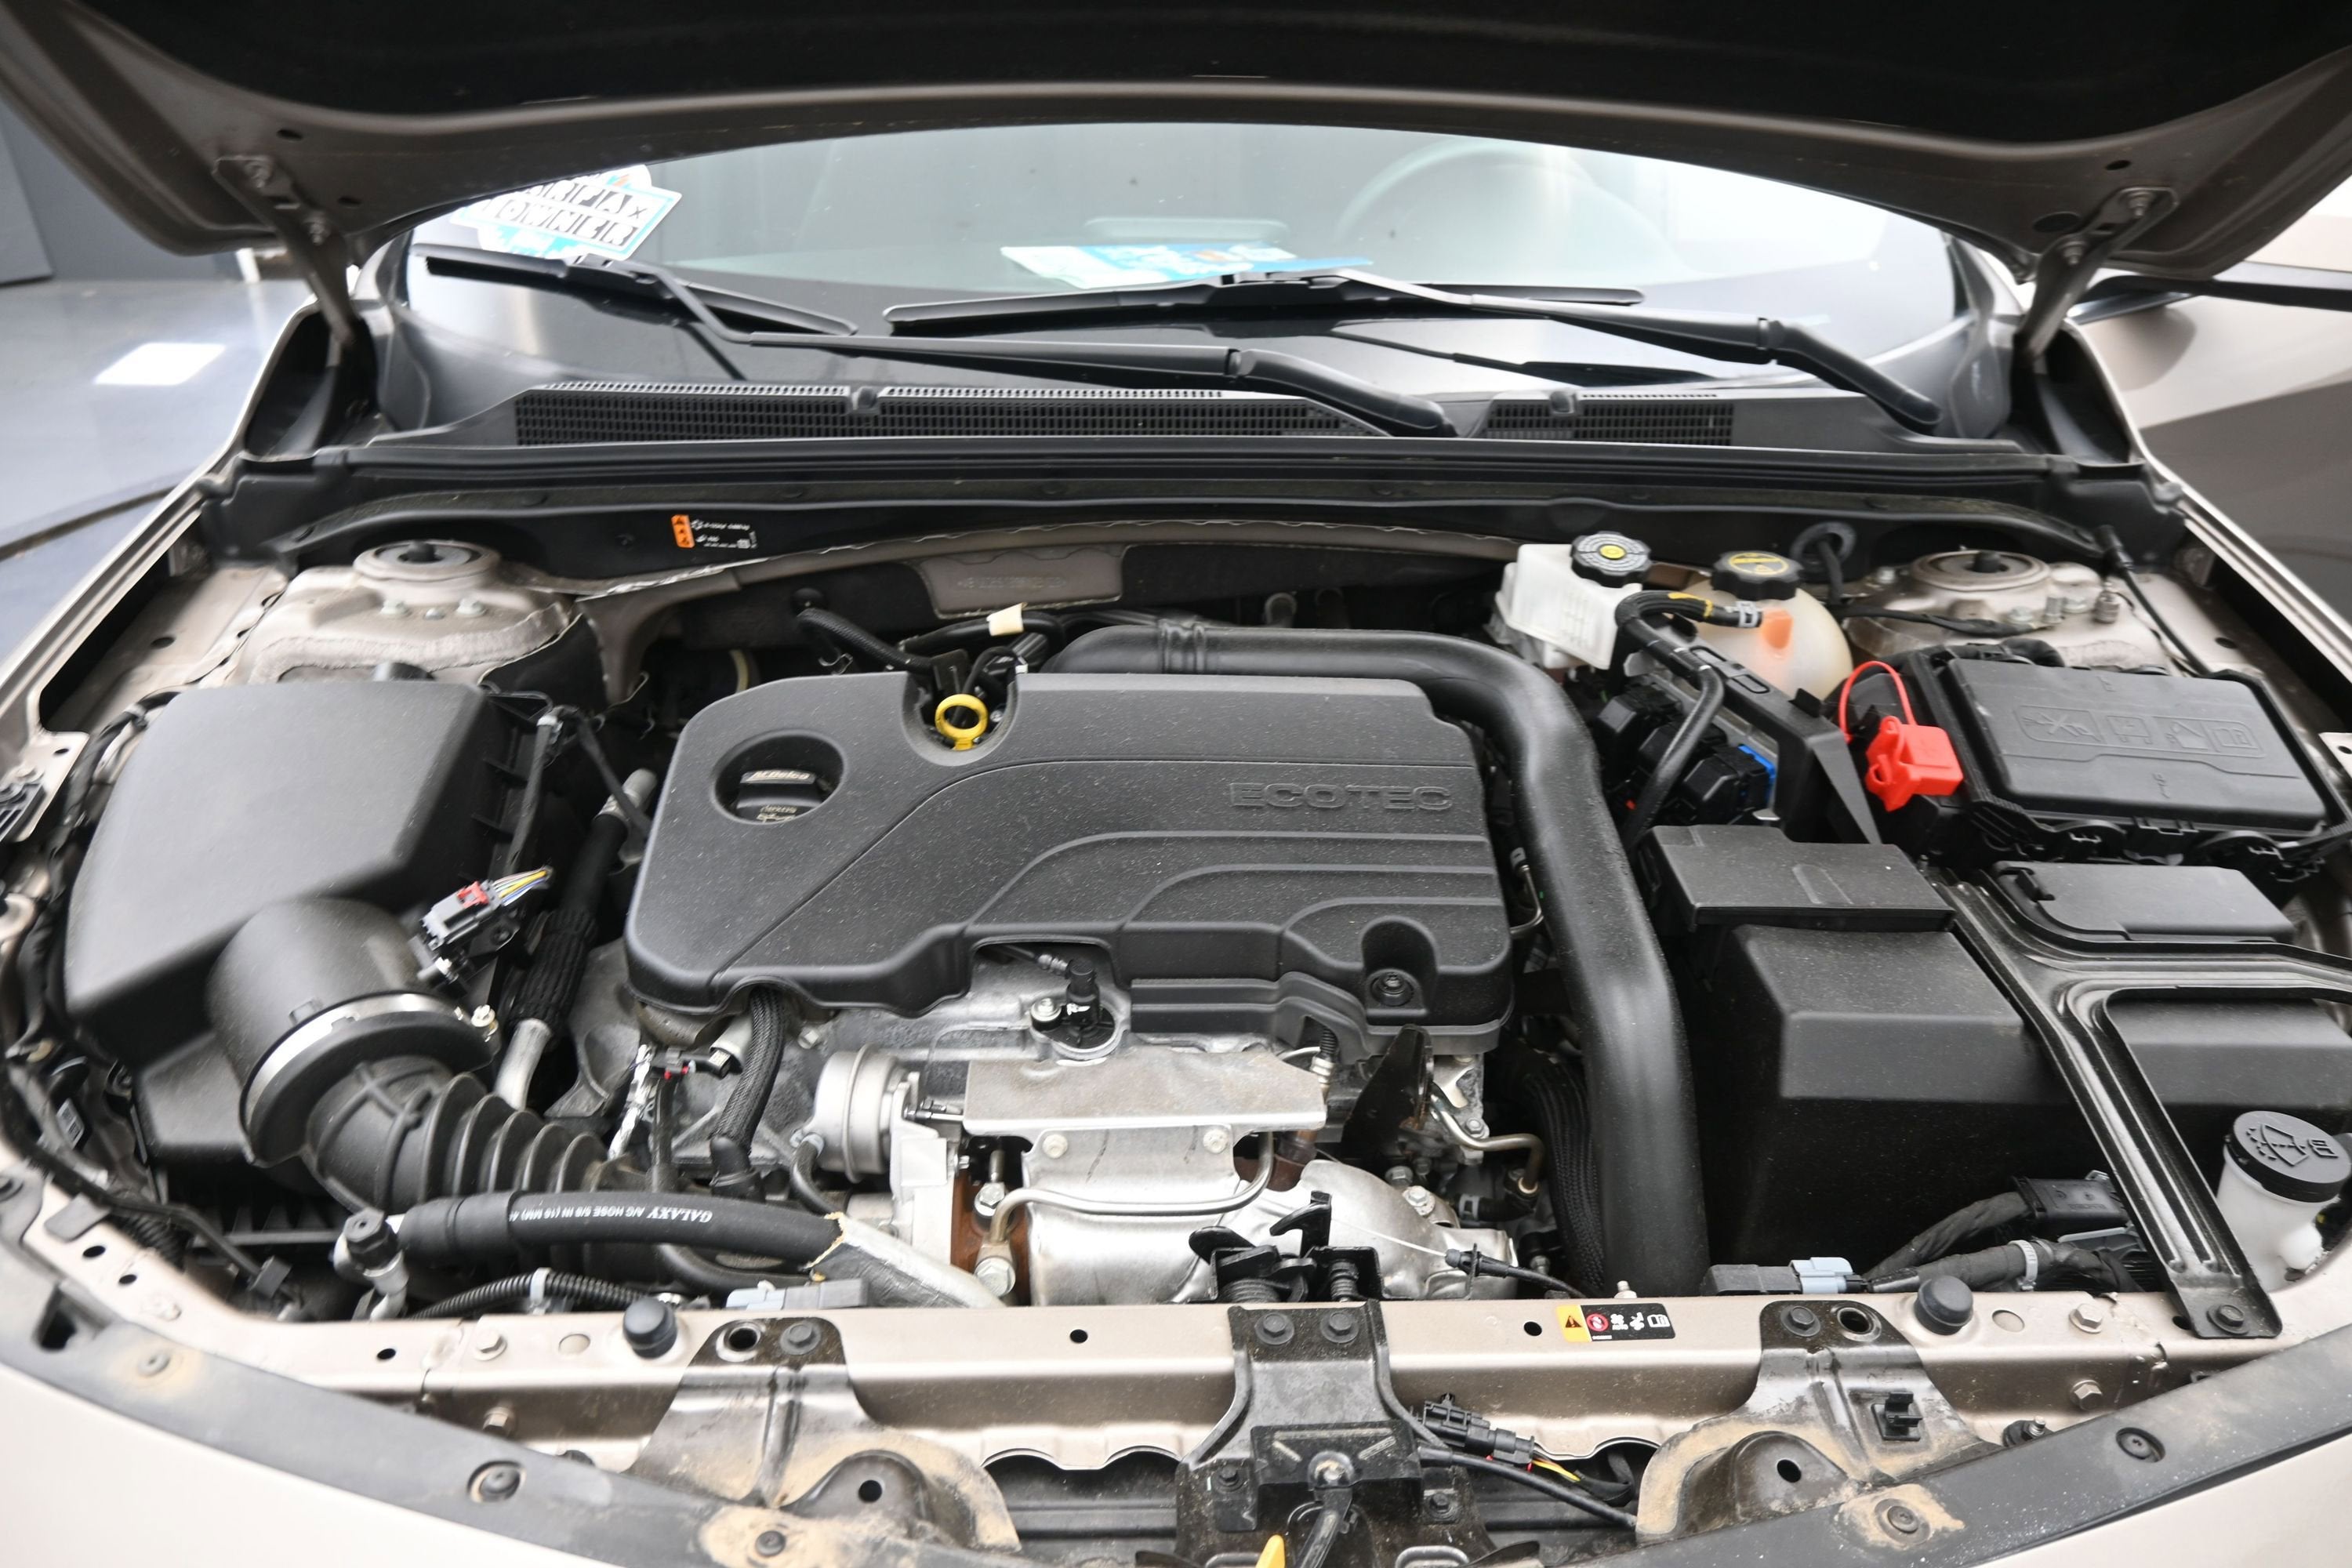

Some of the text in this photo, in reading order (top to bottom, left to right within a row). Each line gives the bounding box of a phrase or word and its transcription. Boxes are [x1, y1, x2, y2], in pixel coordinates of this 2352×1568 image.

[1229, 783, 1452, 811] ECOTEC
[593, 1205, 625, 1218] HOSE
[646, 1206, 713, 1223] GALAXY
